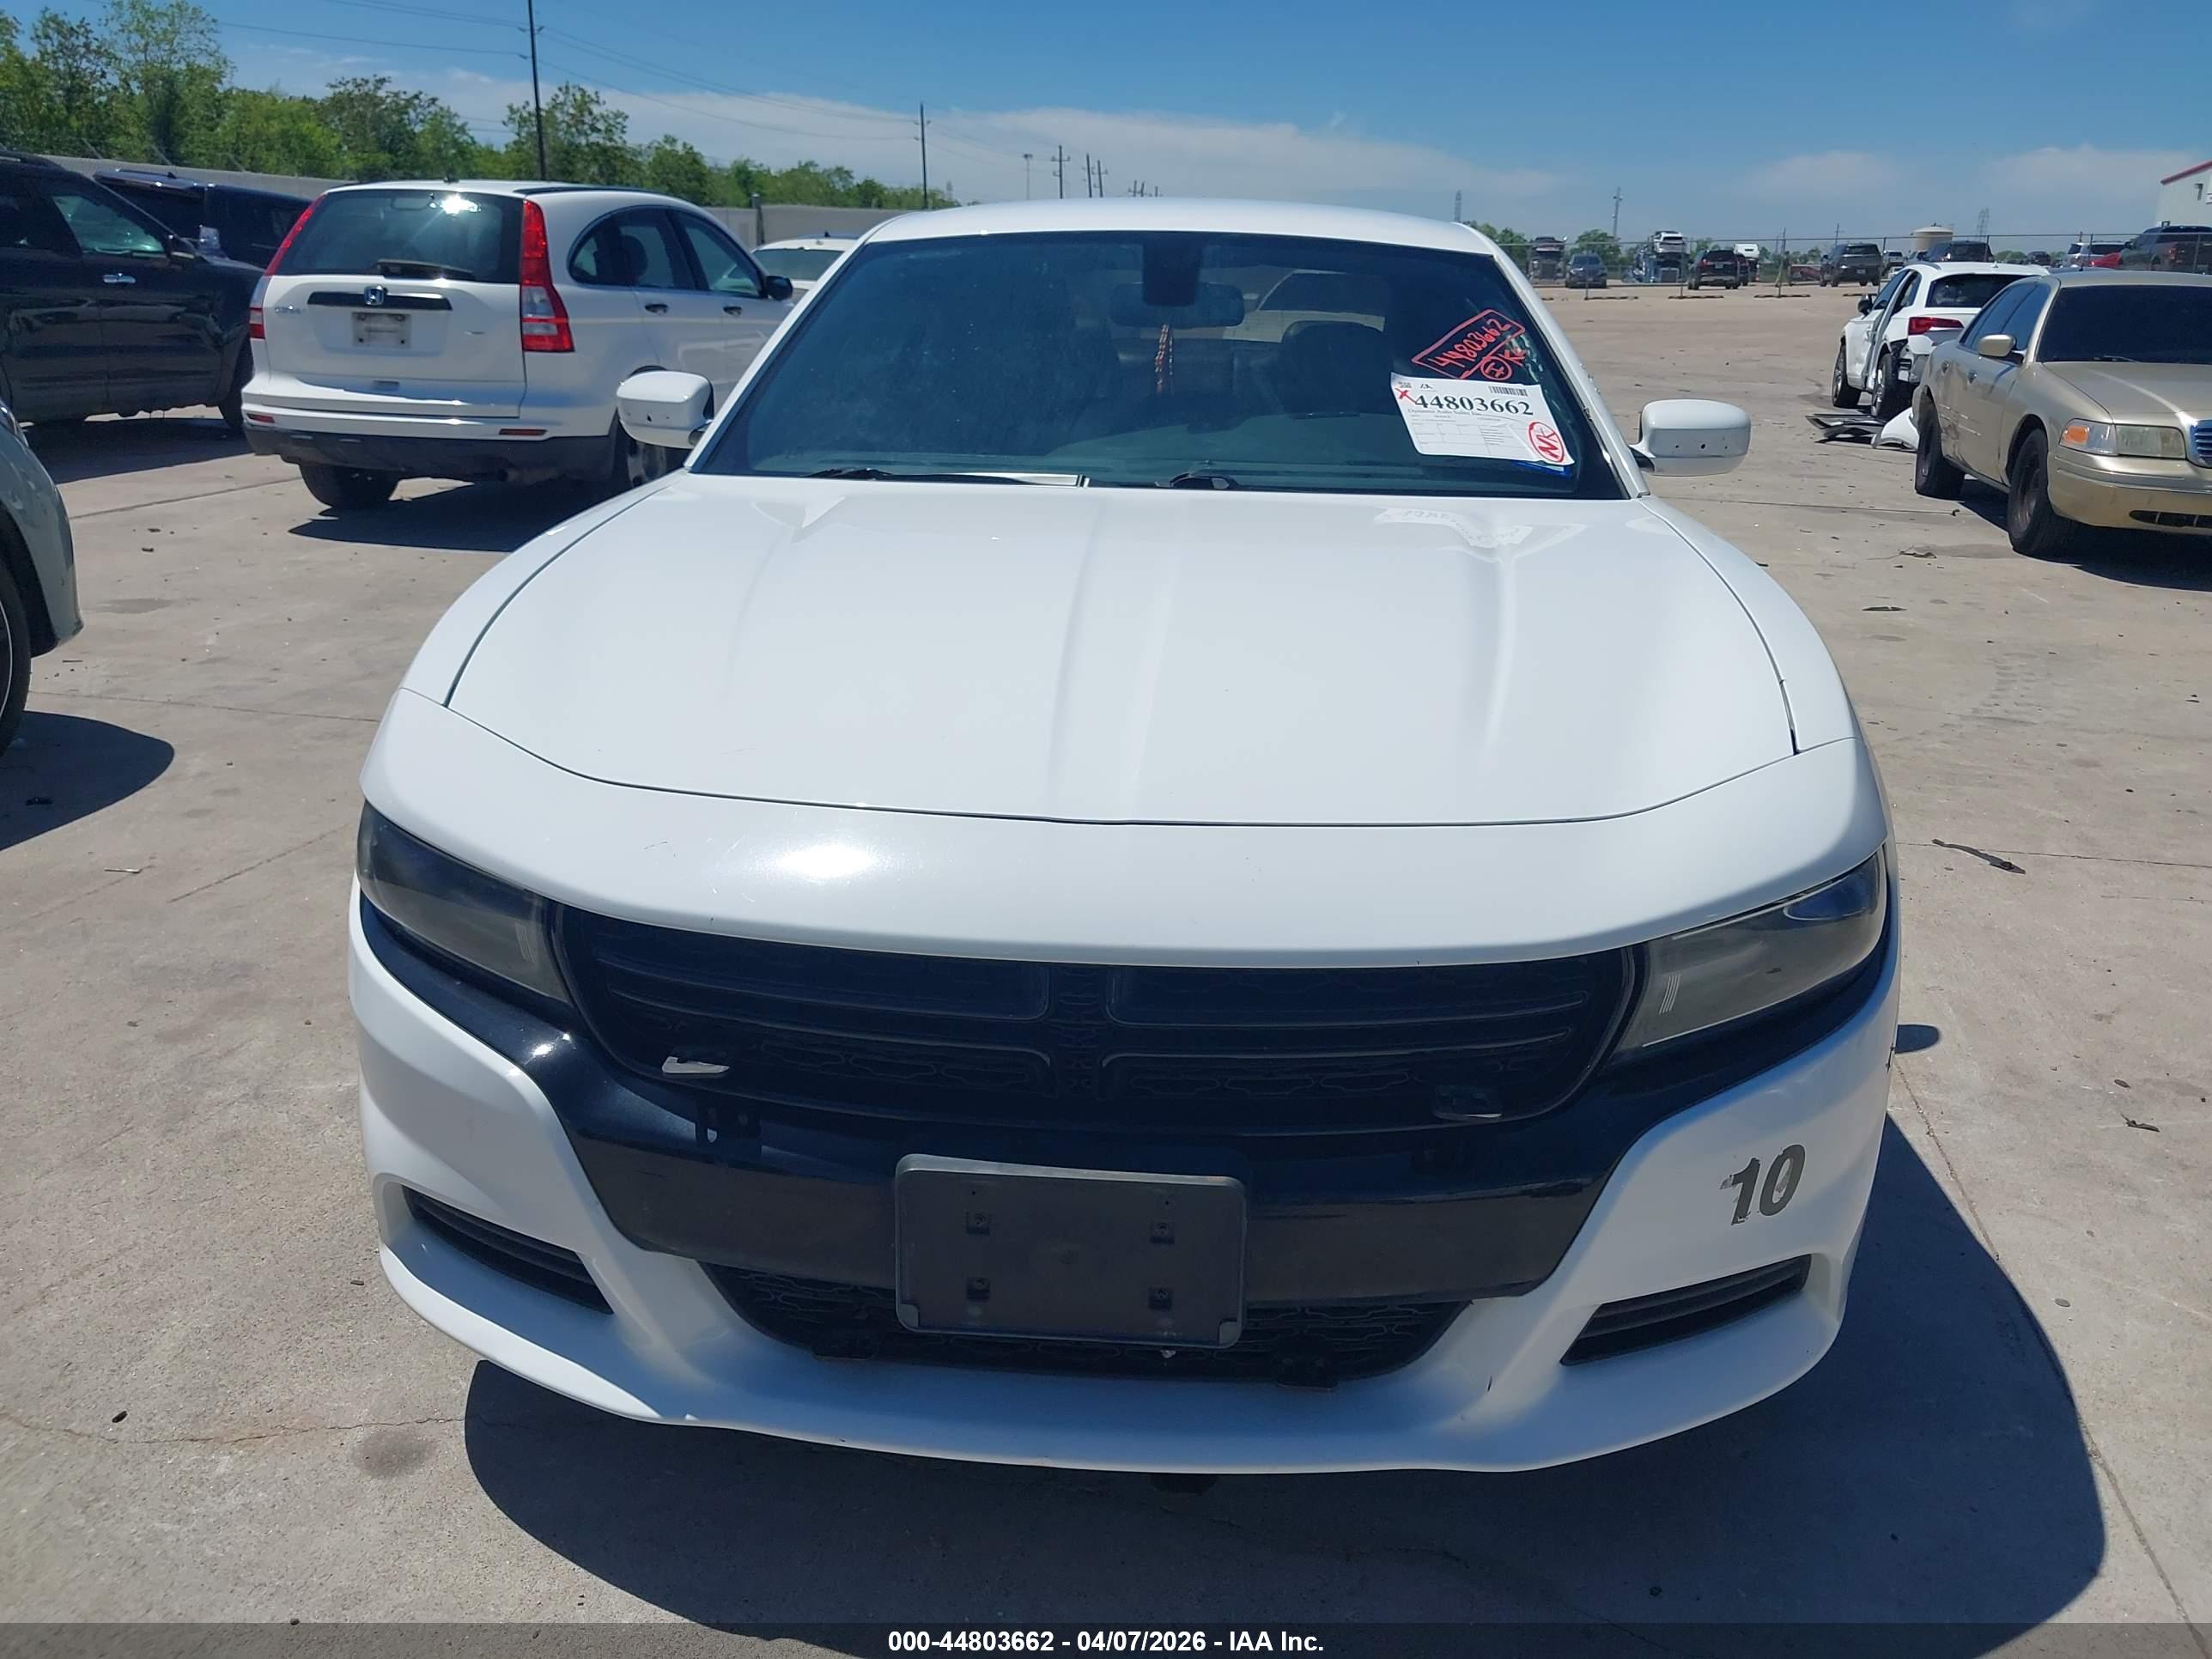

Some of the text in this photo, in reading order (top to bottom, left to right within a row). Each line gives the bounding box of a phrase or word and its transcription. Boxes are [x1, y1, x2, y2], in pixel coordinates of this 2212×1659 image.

[1427, 319, 1512, 368] 44803662
[1414, 394, 1534, 416] 44803662
[1718, 1143, 1806, 1225] 10
